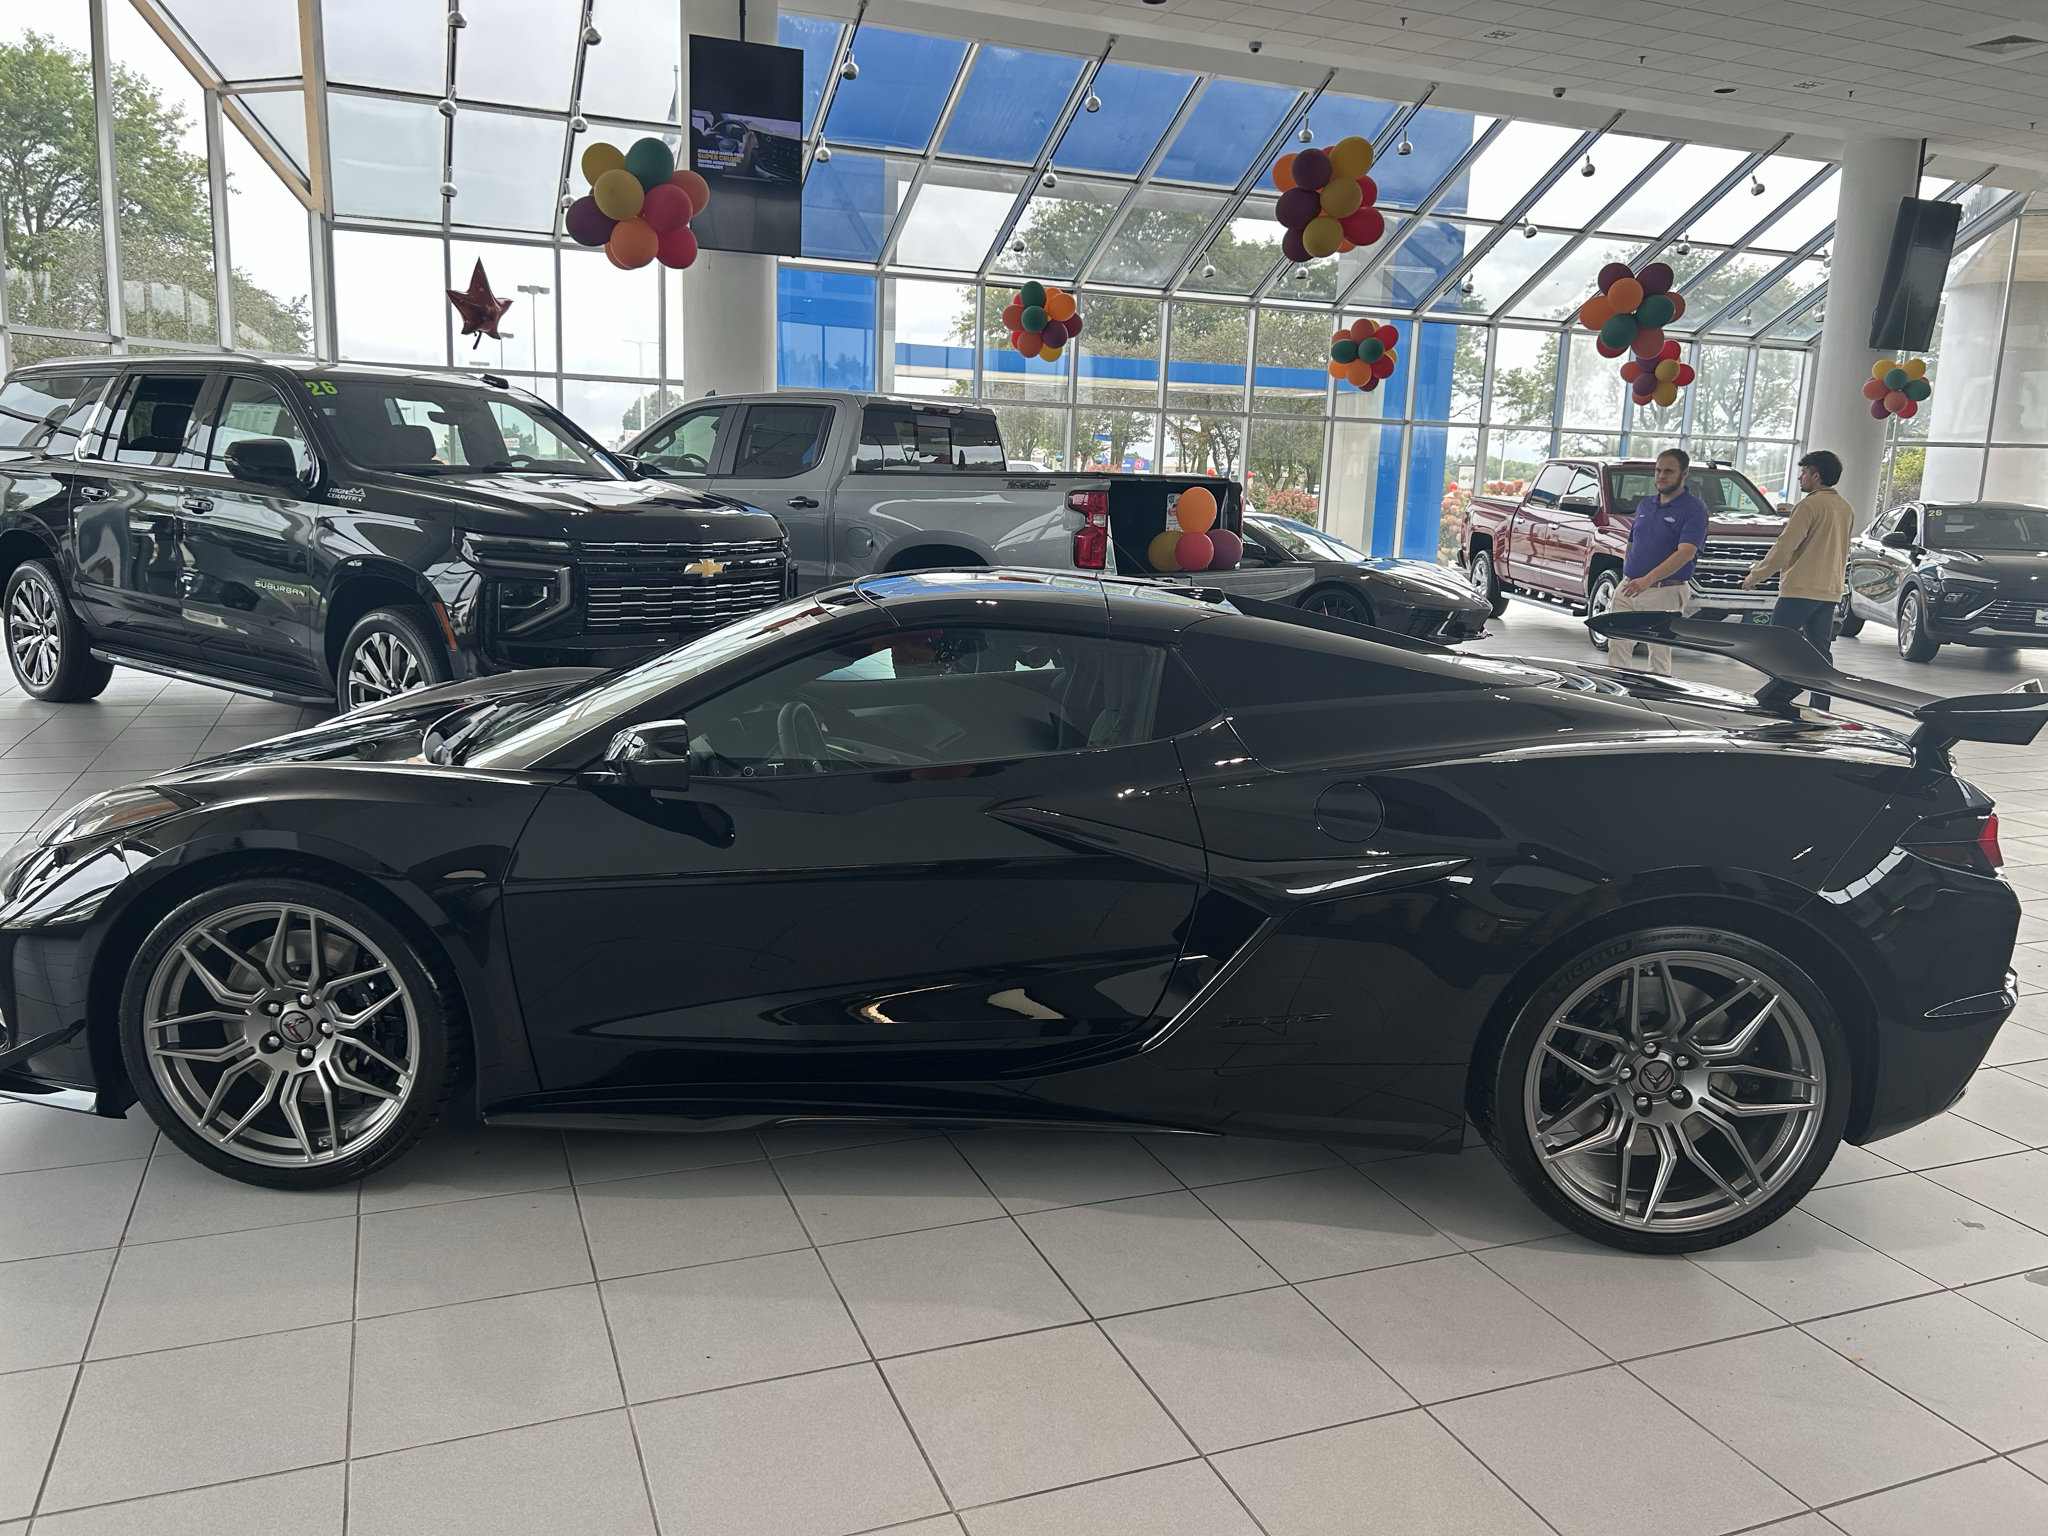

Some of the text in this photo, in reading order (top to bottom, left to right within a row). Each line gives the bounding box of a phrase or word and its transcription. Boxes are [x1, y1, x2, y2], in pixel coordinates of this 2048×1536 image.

[719, 155, 741, 163] CRUISE
[304, 380, 338, 396] 26
[329, 487, 350, 495] HIGH
[327, 493, 363, 502] COUNTRY
[1928, 509, 1943, 517] 26
[254, 580, 307, 597] SUBURBAN
[1556, 941, 1629, 989] MICHELIN
[1664, 932, 1691, 940] SPORT
[1768, 1122, 1792, 1160] FORGED
